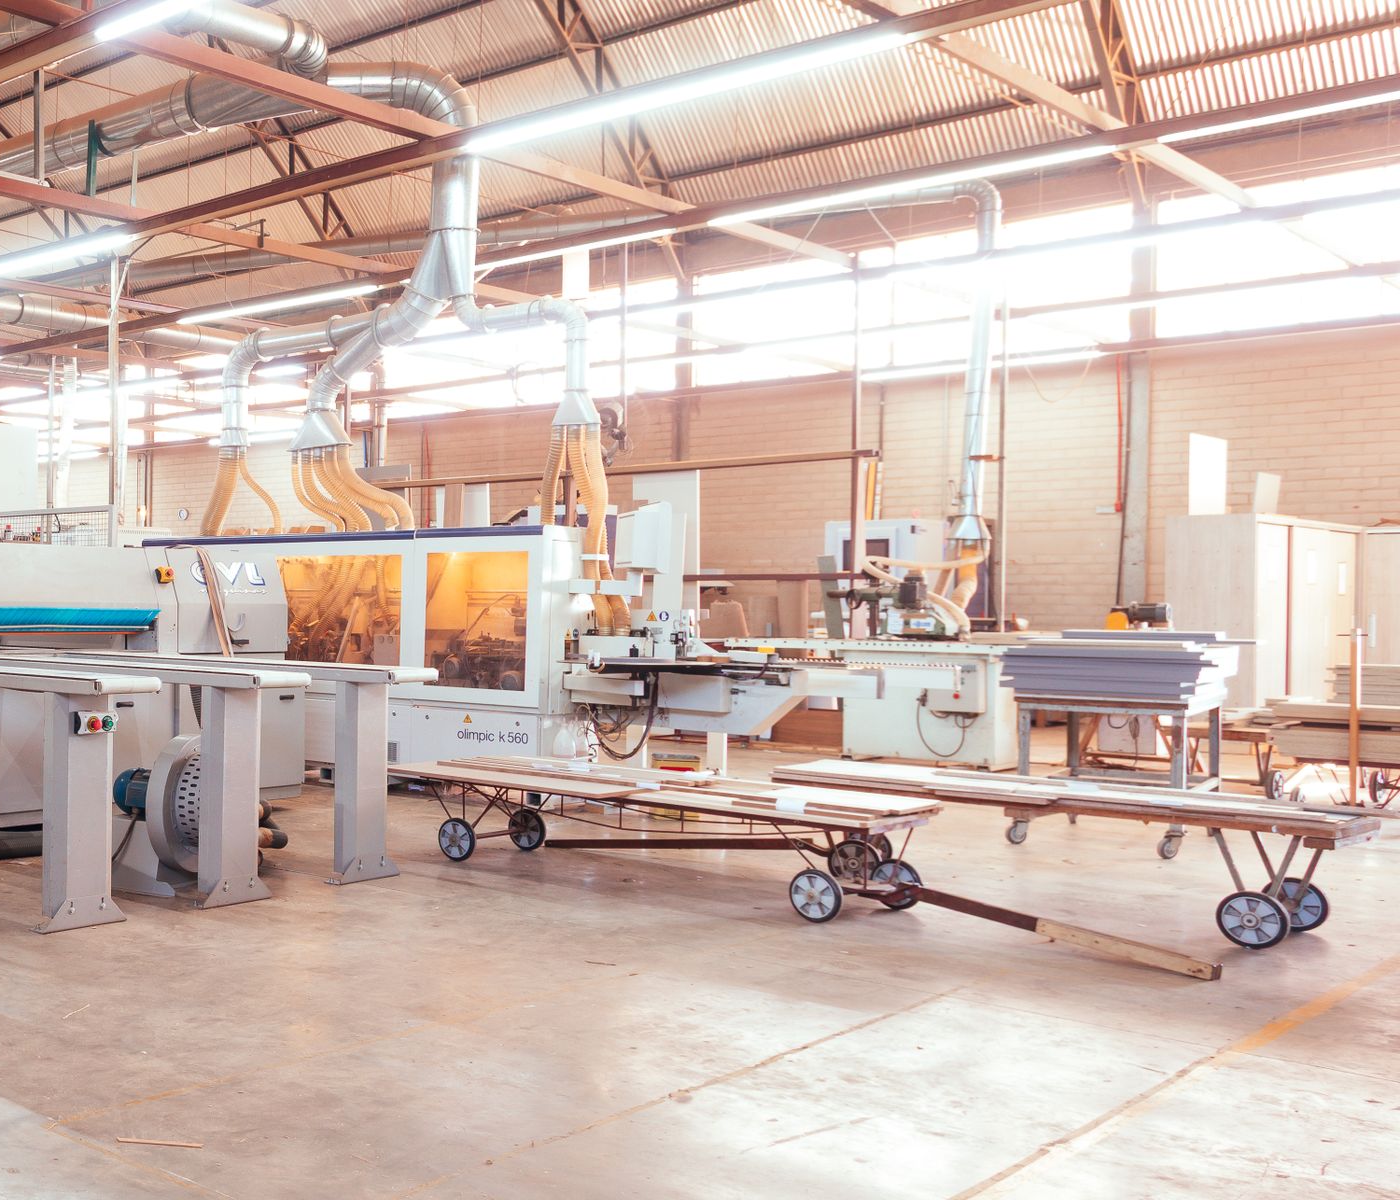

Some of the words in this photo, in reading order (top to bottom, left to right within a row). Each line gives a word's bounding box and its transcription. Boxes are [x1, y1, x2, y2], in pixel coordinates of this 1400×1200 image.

[190, 561, 265, 586] CVL
[457, 728, 495, 743] olimpic
[498, 731, 506, 743] k
[507, 732, 529, 745] 560
